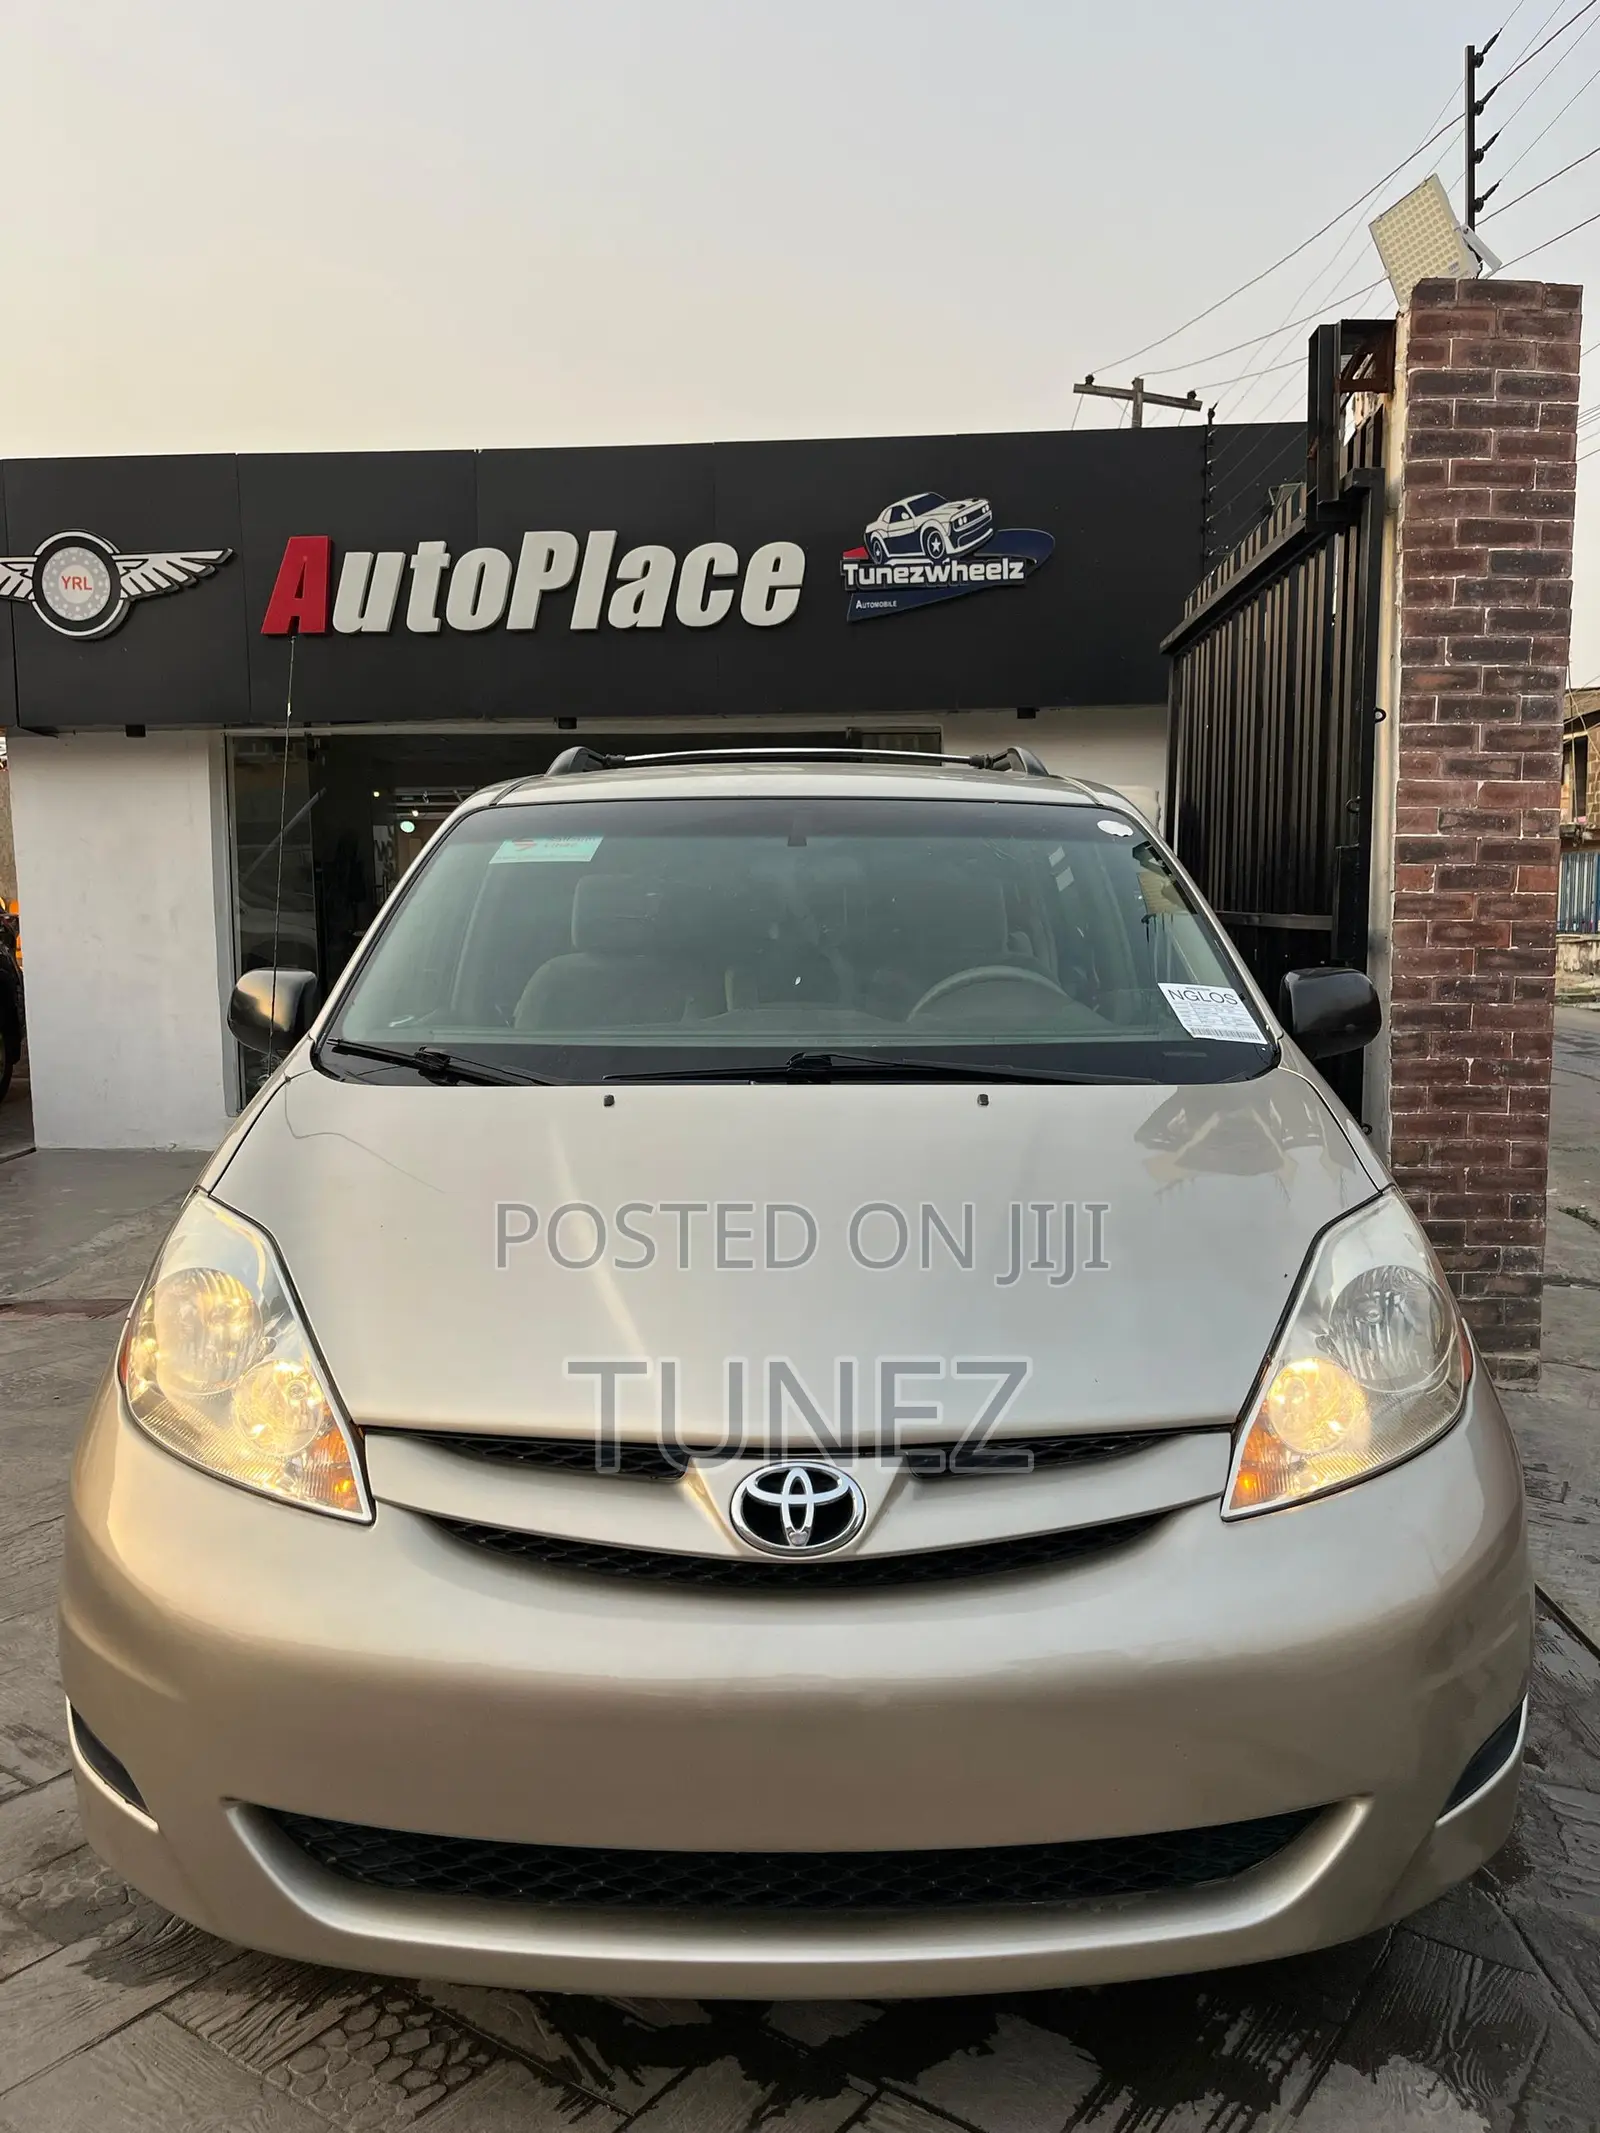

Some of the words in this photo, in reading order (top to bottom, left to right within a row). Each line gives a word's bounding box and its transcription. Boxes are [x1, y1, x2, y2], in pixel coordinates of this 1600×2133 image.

[843, 558, 1025, 586] Tunezwheelz
[61, 575, 93, 591] YRL
[261, 530, 805, 635] AutoPlace
[855, 599, 897, 610] AUTOMOBILE
[1167, 988, 1238, 1005] NGLOS
